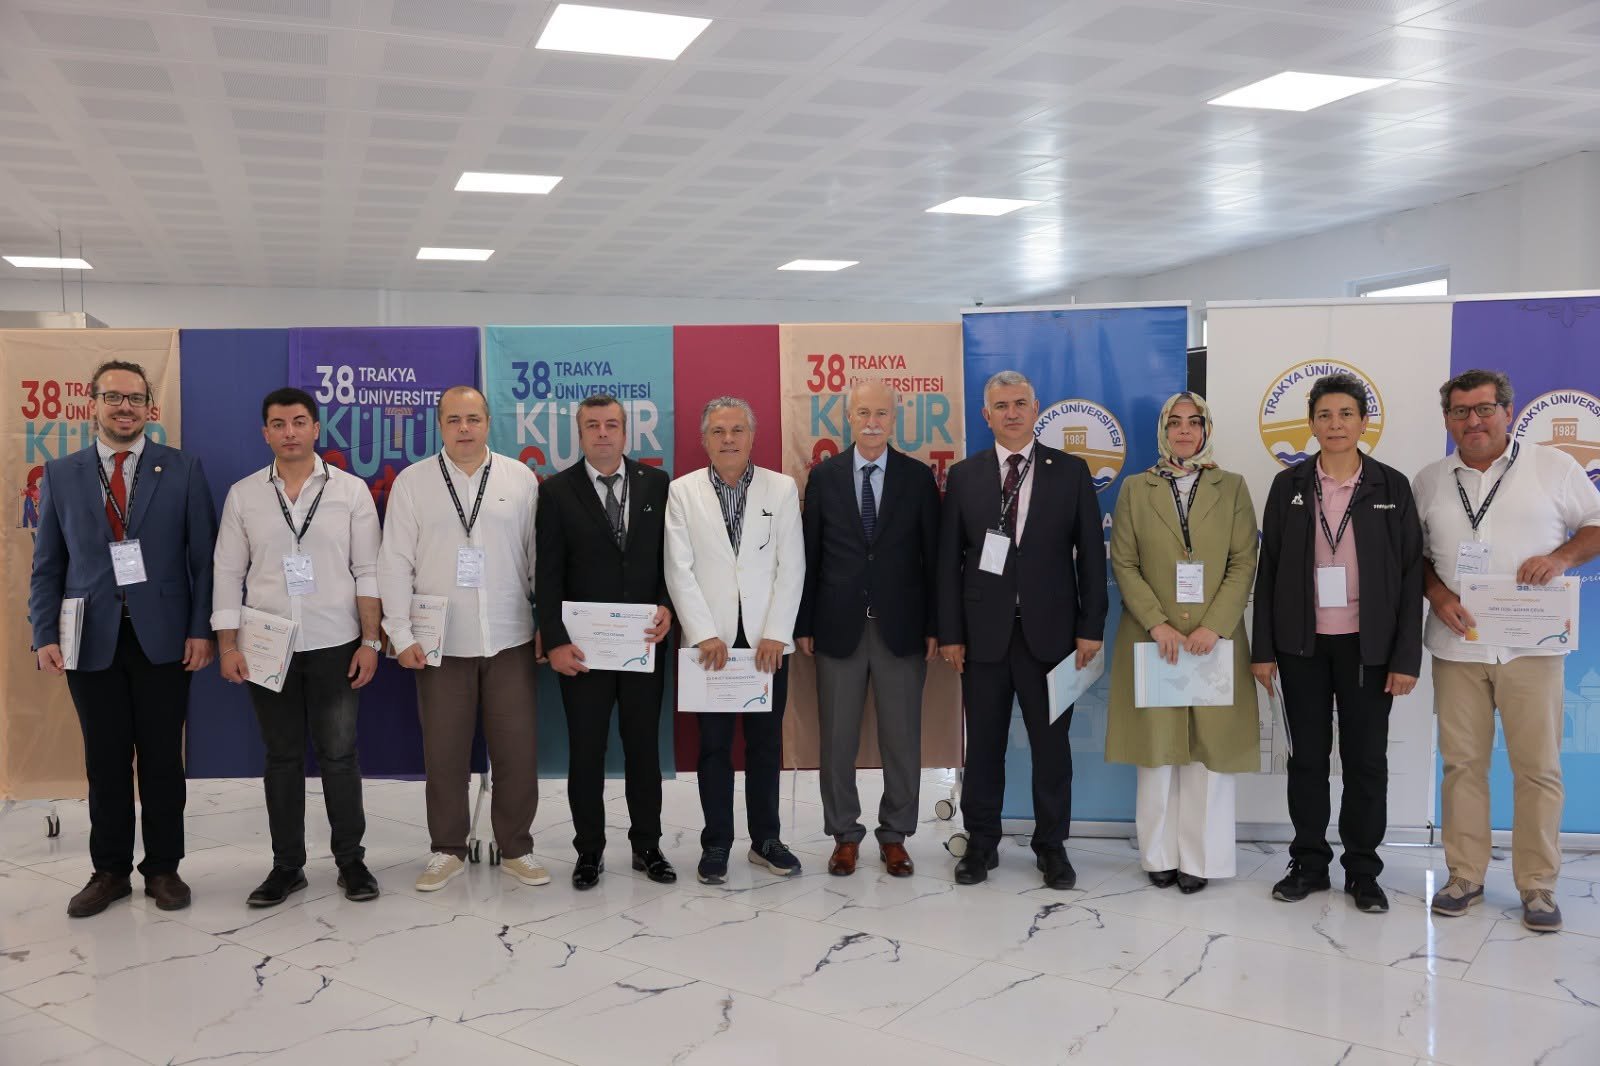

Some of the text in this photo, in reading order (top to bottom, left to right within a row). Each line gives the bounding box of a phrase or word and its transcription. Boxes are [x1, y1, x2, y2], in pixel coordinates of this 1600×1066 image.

[358, 367, 416, 382] TRAKYA
[512, 361, 552, 400] 38
[554, 361, 612, 377] TRAKYA
[807, 354, 845, 393] 38
[849, 355, 906, 370] TRAKYA
[21, 380, 62, 419] 38
[316, 365, 355, 404] 38
[358, 388, 440, 405] ÜNİVERSİTE
[1264, 371, 1304, 416] TRAKYA
[1061, 403, 1123, 447] ÜNİVERSİTESİ
[1515, 401, 1549, 438] TRAKYA
[1554, 425, 1576, 436] 1982
[319, 406, 443, 478] KÜLTÜ
[1065, 434, 1085, 445] 1982
